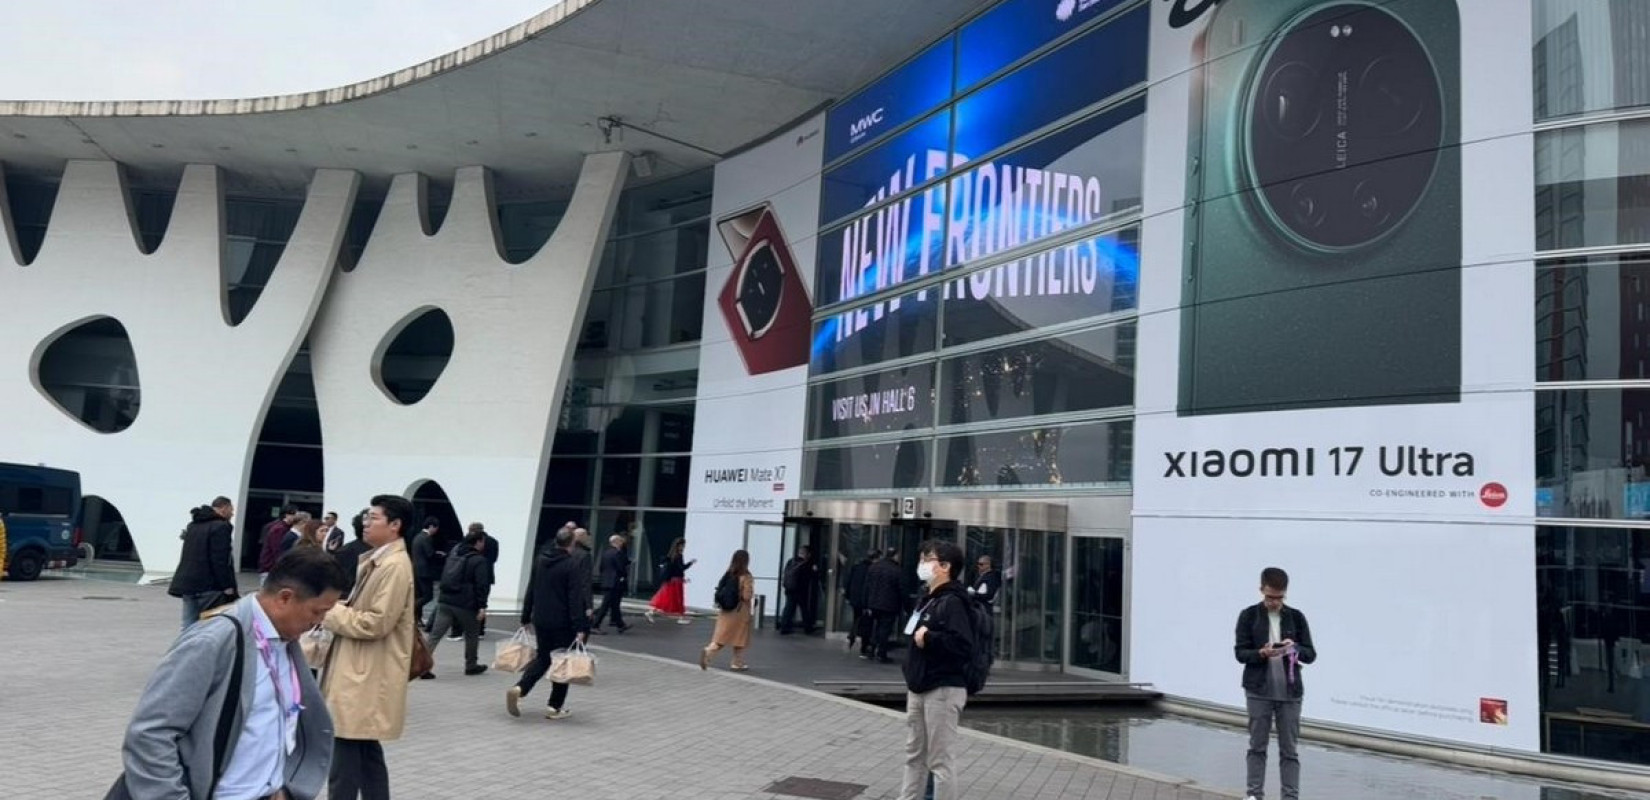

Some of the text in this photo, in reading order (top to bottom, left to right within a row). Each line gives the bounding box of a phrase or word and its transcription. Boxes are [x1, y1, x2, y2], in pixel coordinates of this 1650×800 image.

[850, 107, 884, 136] MWC
[1335, 131, 1347, 168] LEICA
[835, 150, 1100, 342] NEW FRONTIERS
[832, 385, 916, 421] VISIT US IN HALL 6
[704, 465, 786, 483] HUAWEI Mate X7
[1328, 446, 1365, 477] 17
[1379, 445, 1475, 477] Ultra
[1449, 490, 1475, 499] WITH
